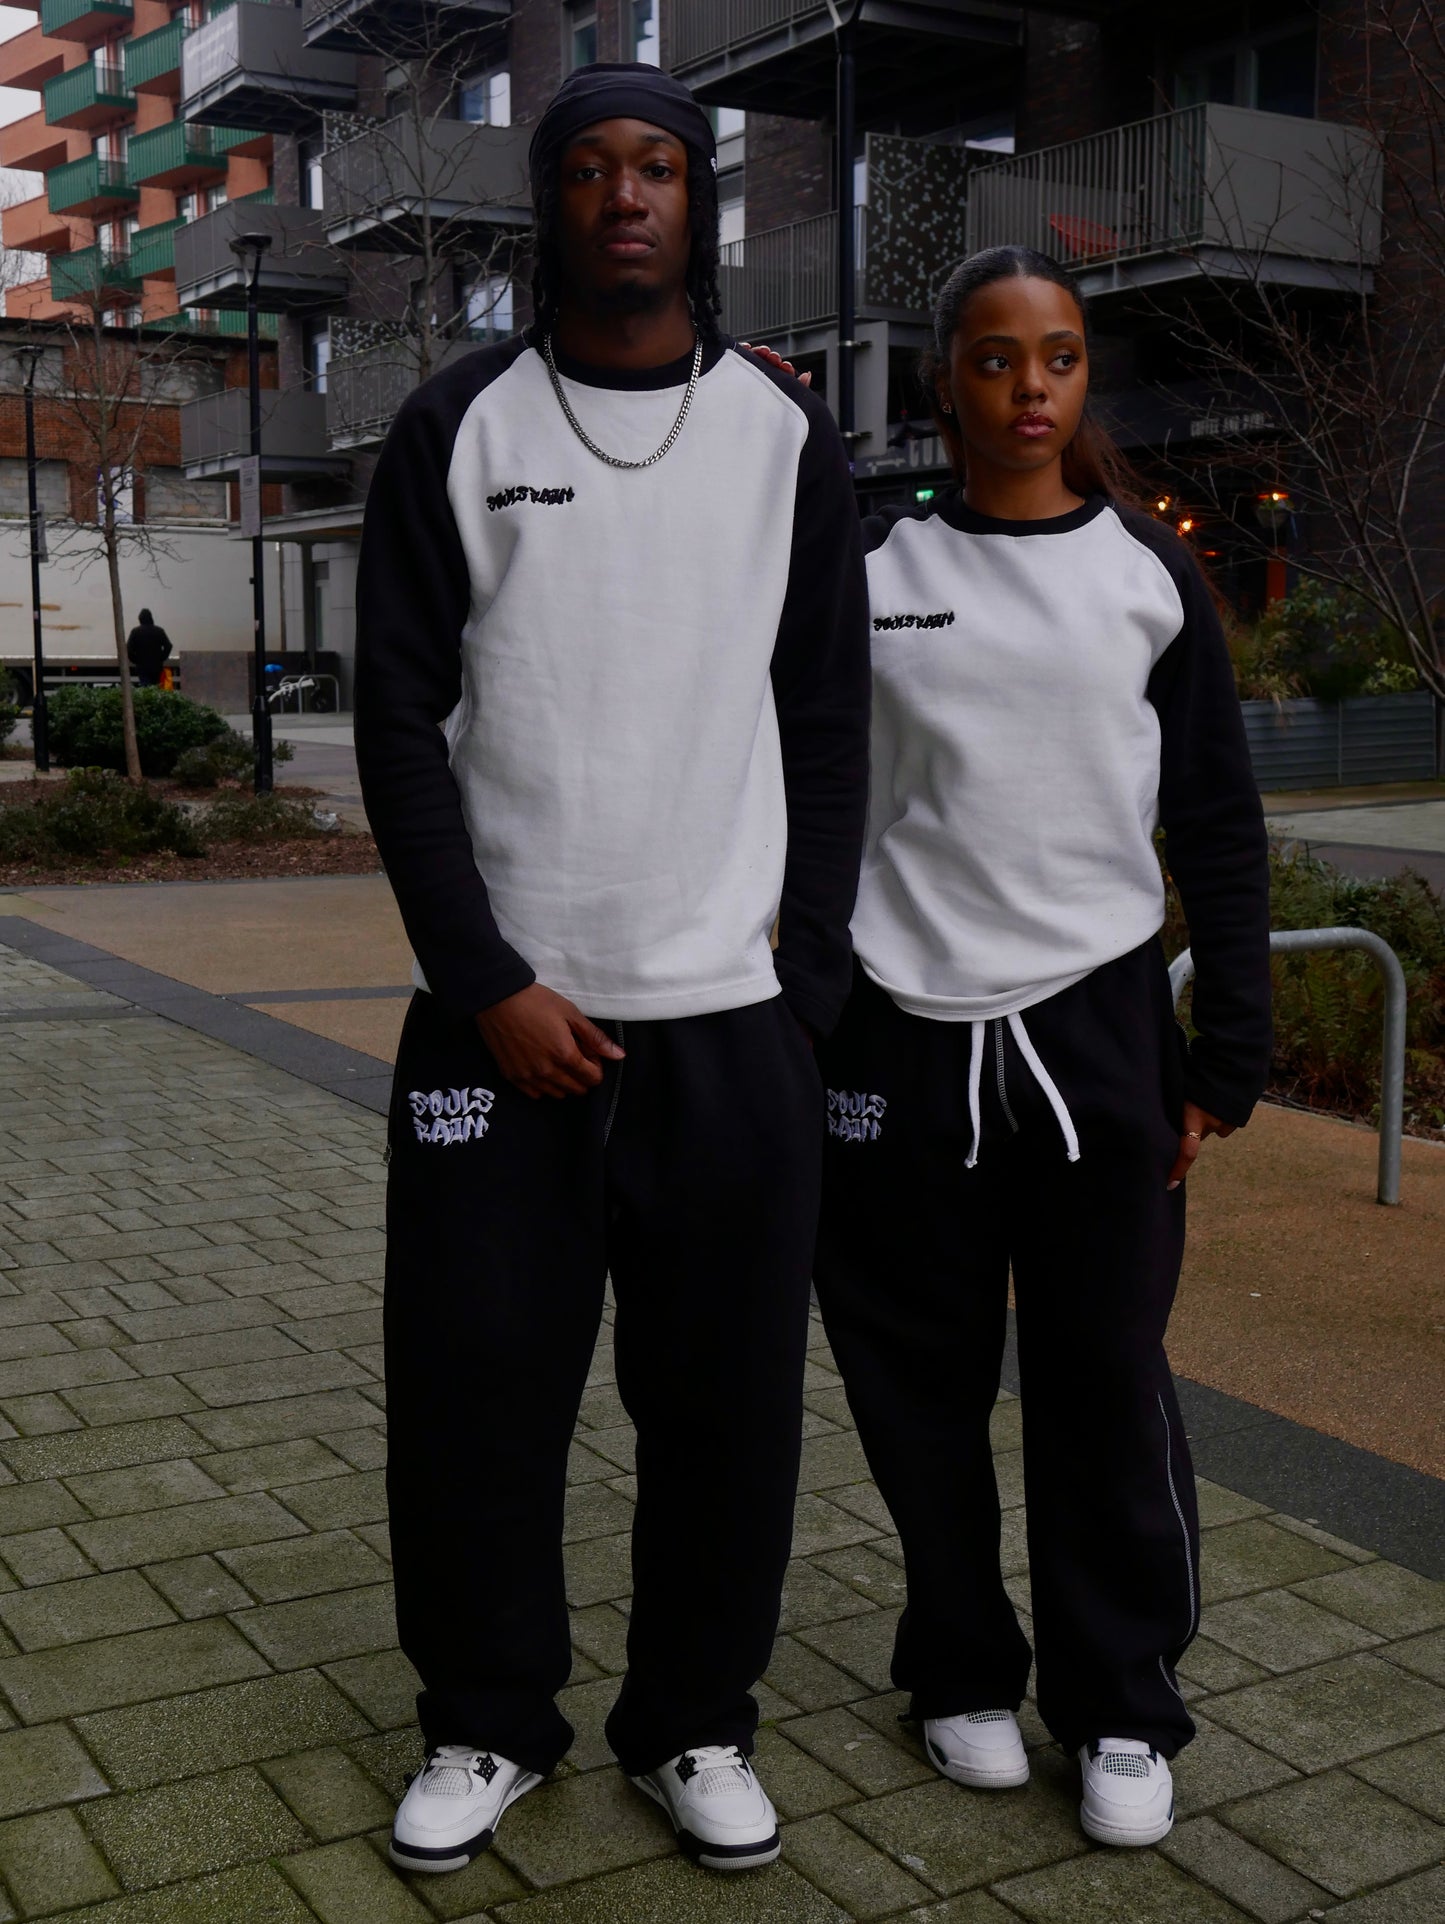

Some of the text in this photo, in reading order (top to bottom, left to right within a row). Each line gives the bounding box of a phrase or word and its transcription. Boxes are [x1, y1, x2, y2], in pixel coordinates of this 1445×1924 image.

[408, 1087, 495, 1116] SOULS
[826, 1088, 887, 1118] SOULS
[412, 1113, 490, 1146] RAIN
[826, 1111, 882, 1142] RAIN
